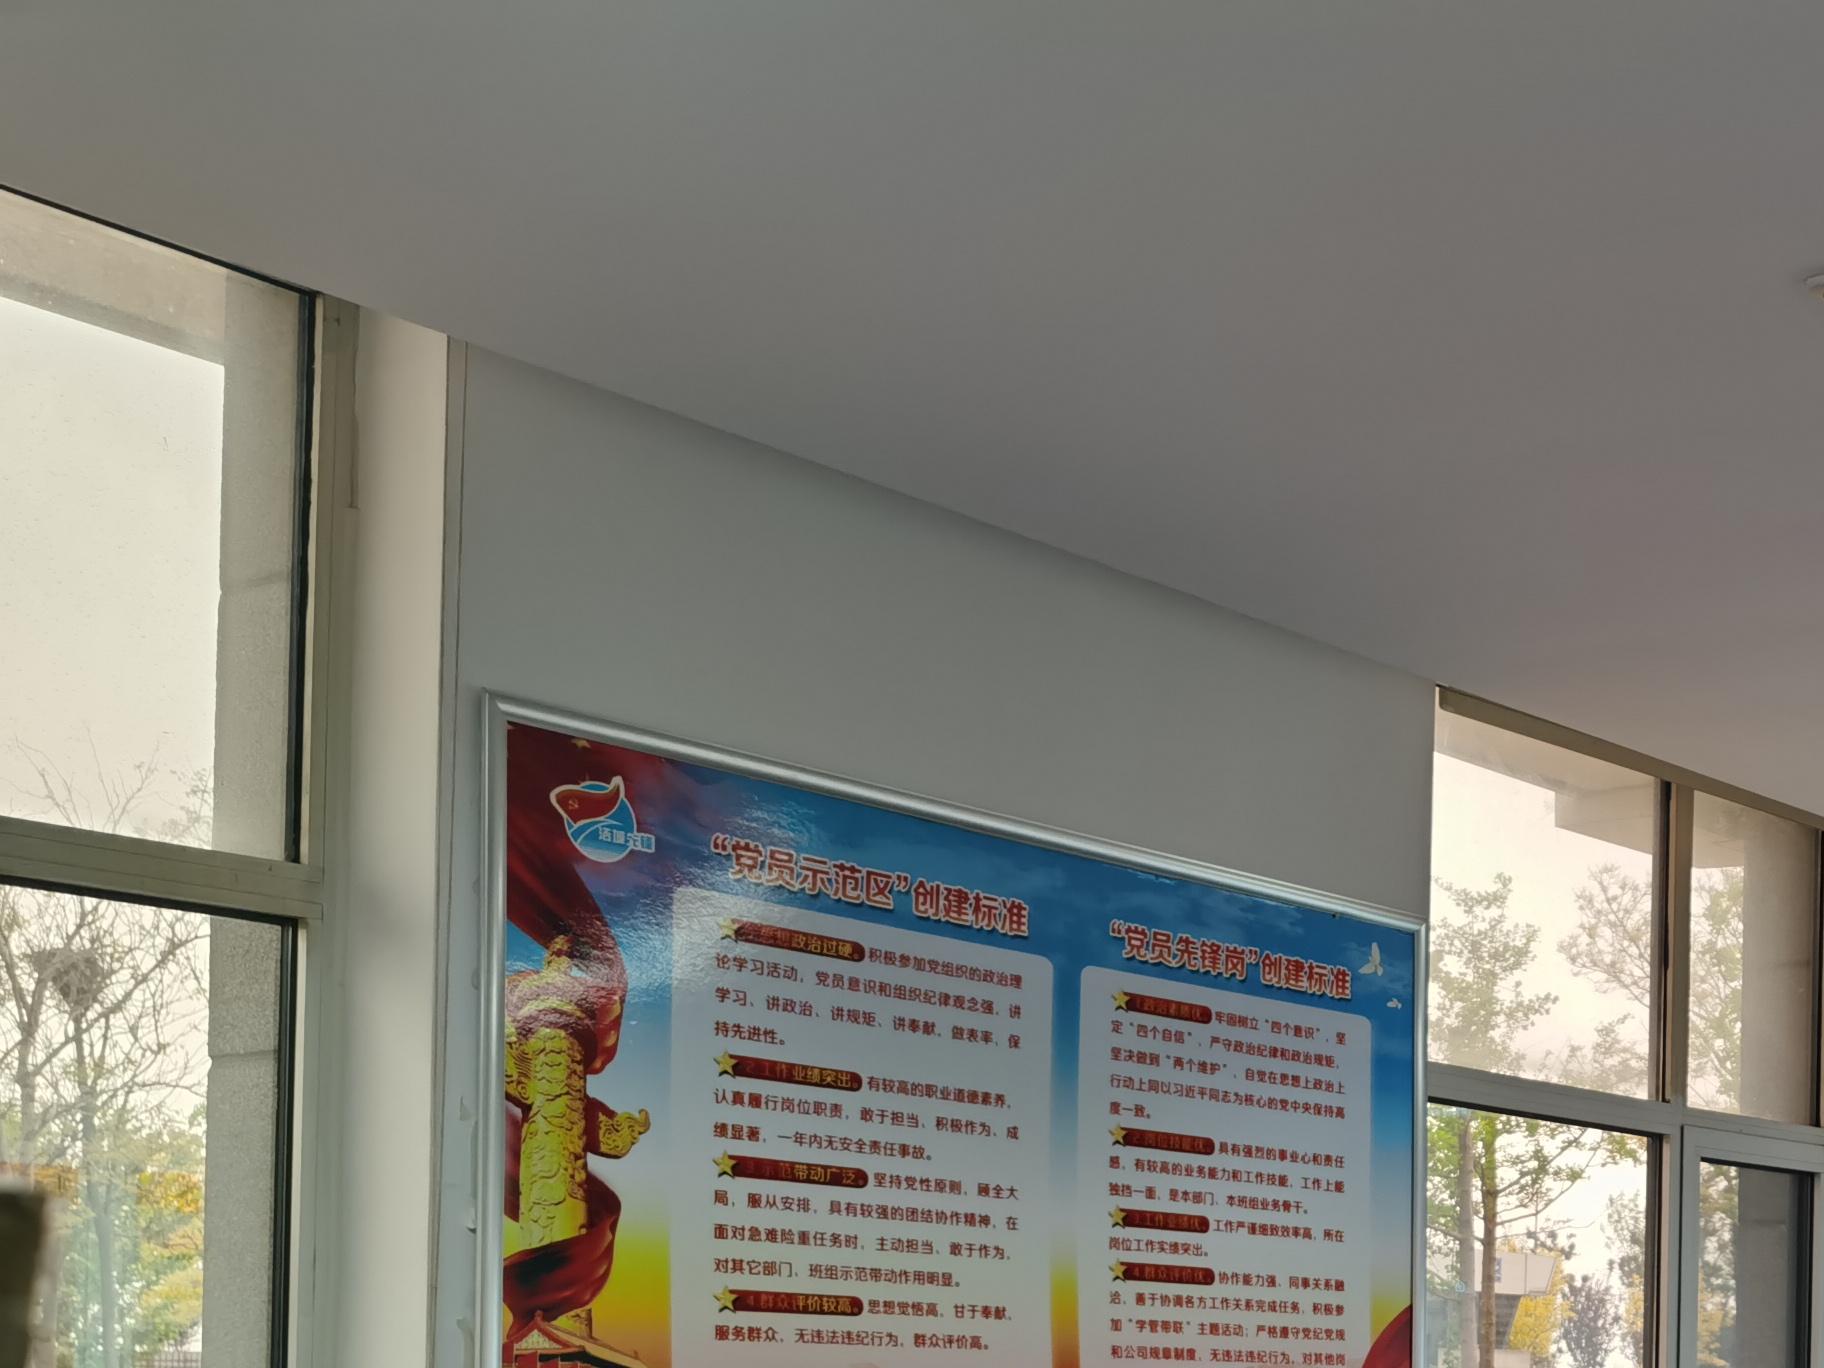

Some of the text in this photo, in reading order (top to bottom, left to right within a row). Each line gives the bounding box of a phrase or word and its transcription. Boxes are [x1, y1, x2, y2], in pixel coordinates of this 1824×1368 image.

[711, 834, 1030, 937] “党员示范区”创建标准
[868, 947, 1023, 989] 积极参加党组织的政治理
[1110, 918, 1352, 1000] “党员先锋岗”创建标准
[714, 1020, 786, 1046] 持先进性。
[1110, 1101, 1151, 1119] 度一致。
[713, 1122, 932, 1161] 绩显著，一年内无安全责任事故。
[1109, 1236, 1209, 1257] 岗位工作实绩突出。
